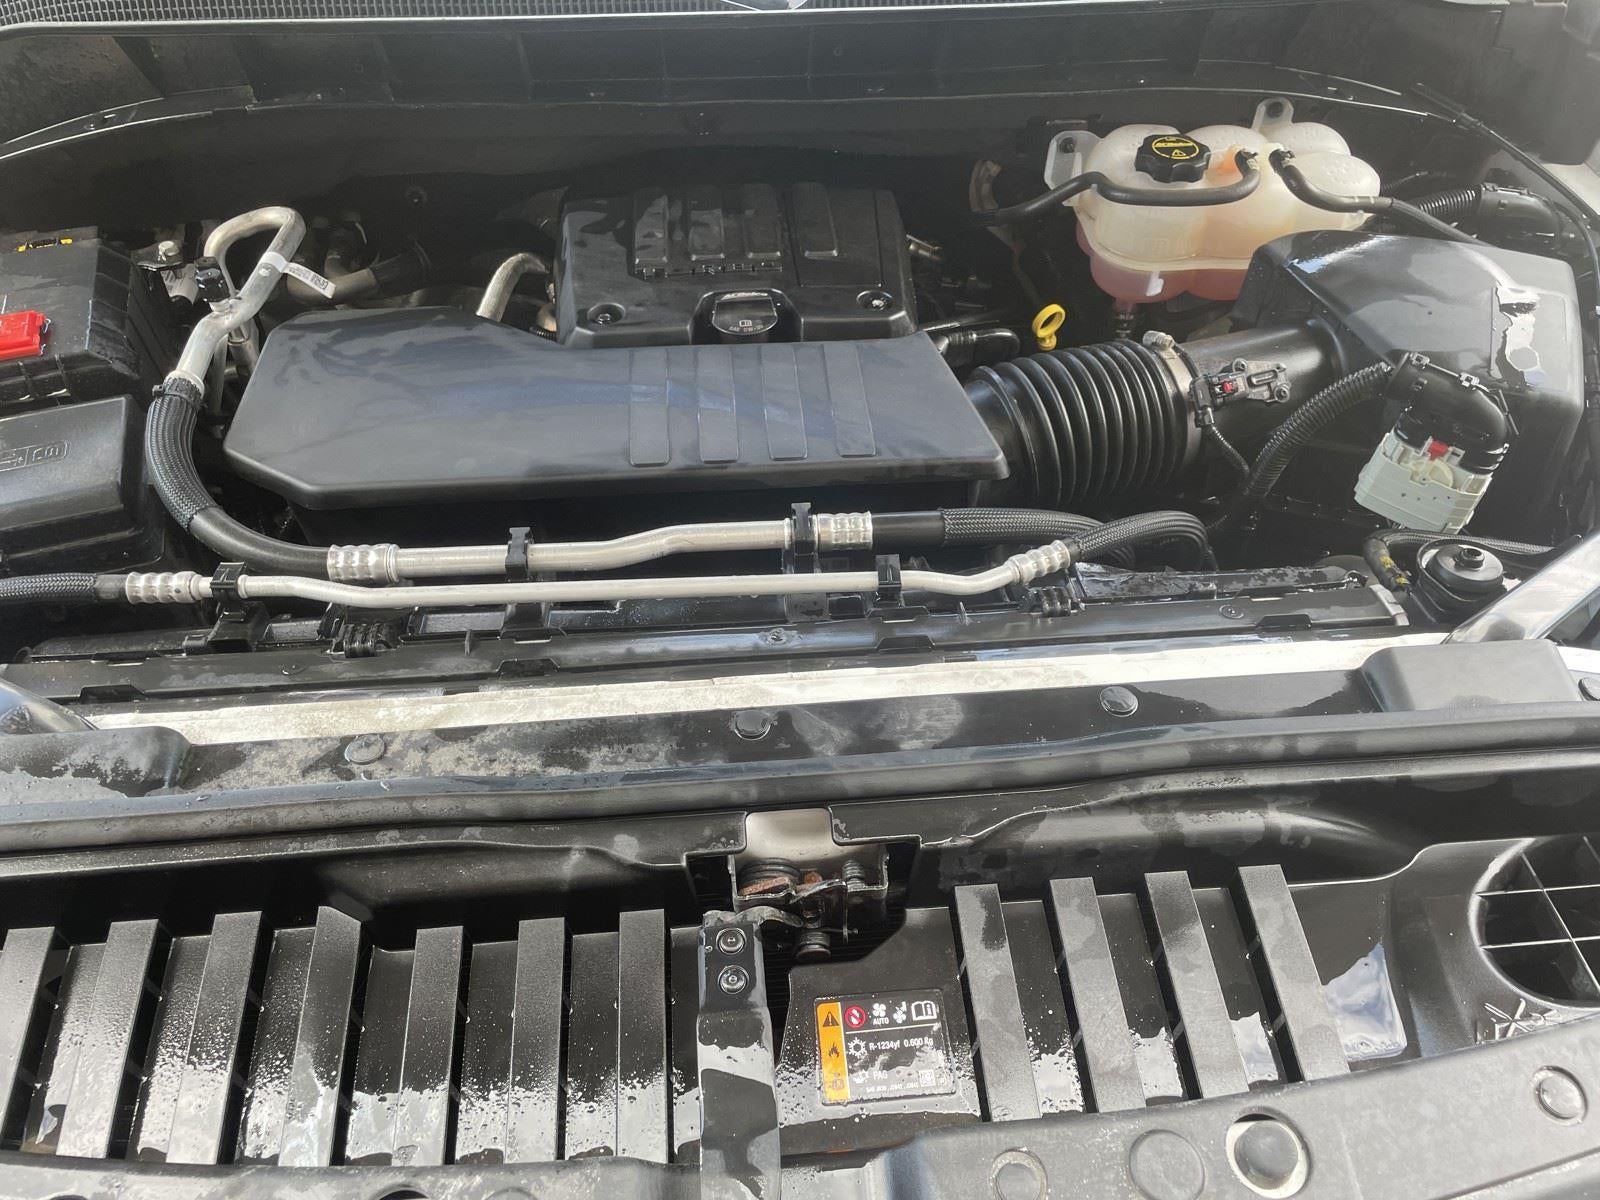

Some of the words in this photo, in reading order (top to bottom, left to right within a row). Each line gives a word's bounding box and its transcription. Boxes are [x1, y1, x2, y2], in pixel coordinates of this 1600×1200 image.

[869, 1039, 900, 1051] R-1234yf
[904, 1037, 924, 1048] 0.600
[873, 1070, 888, 1080] PAG
